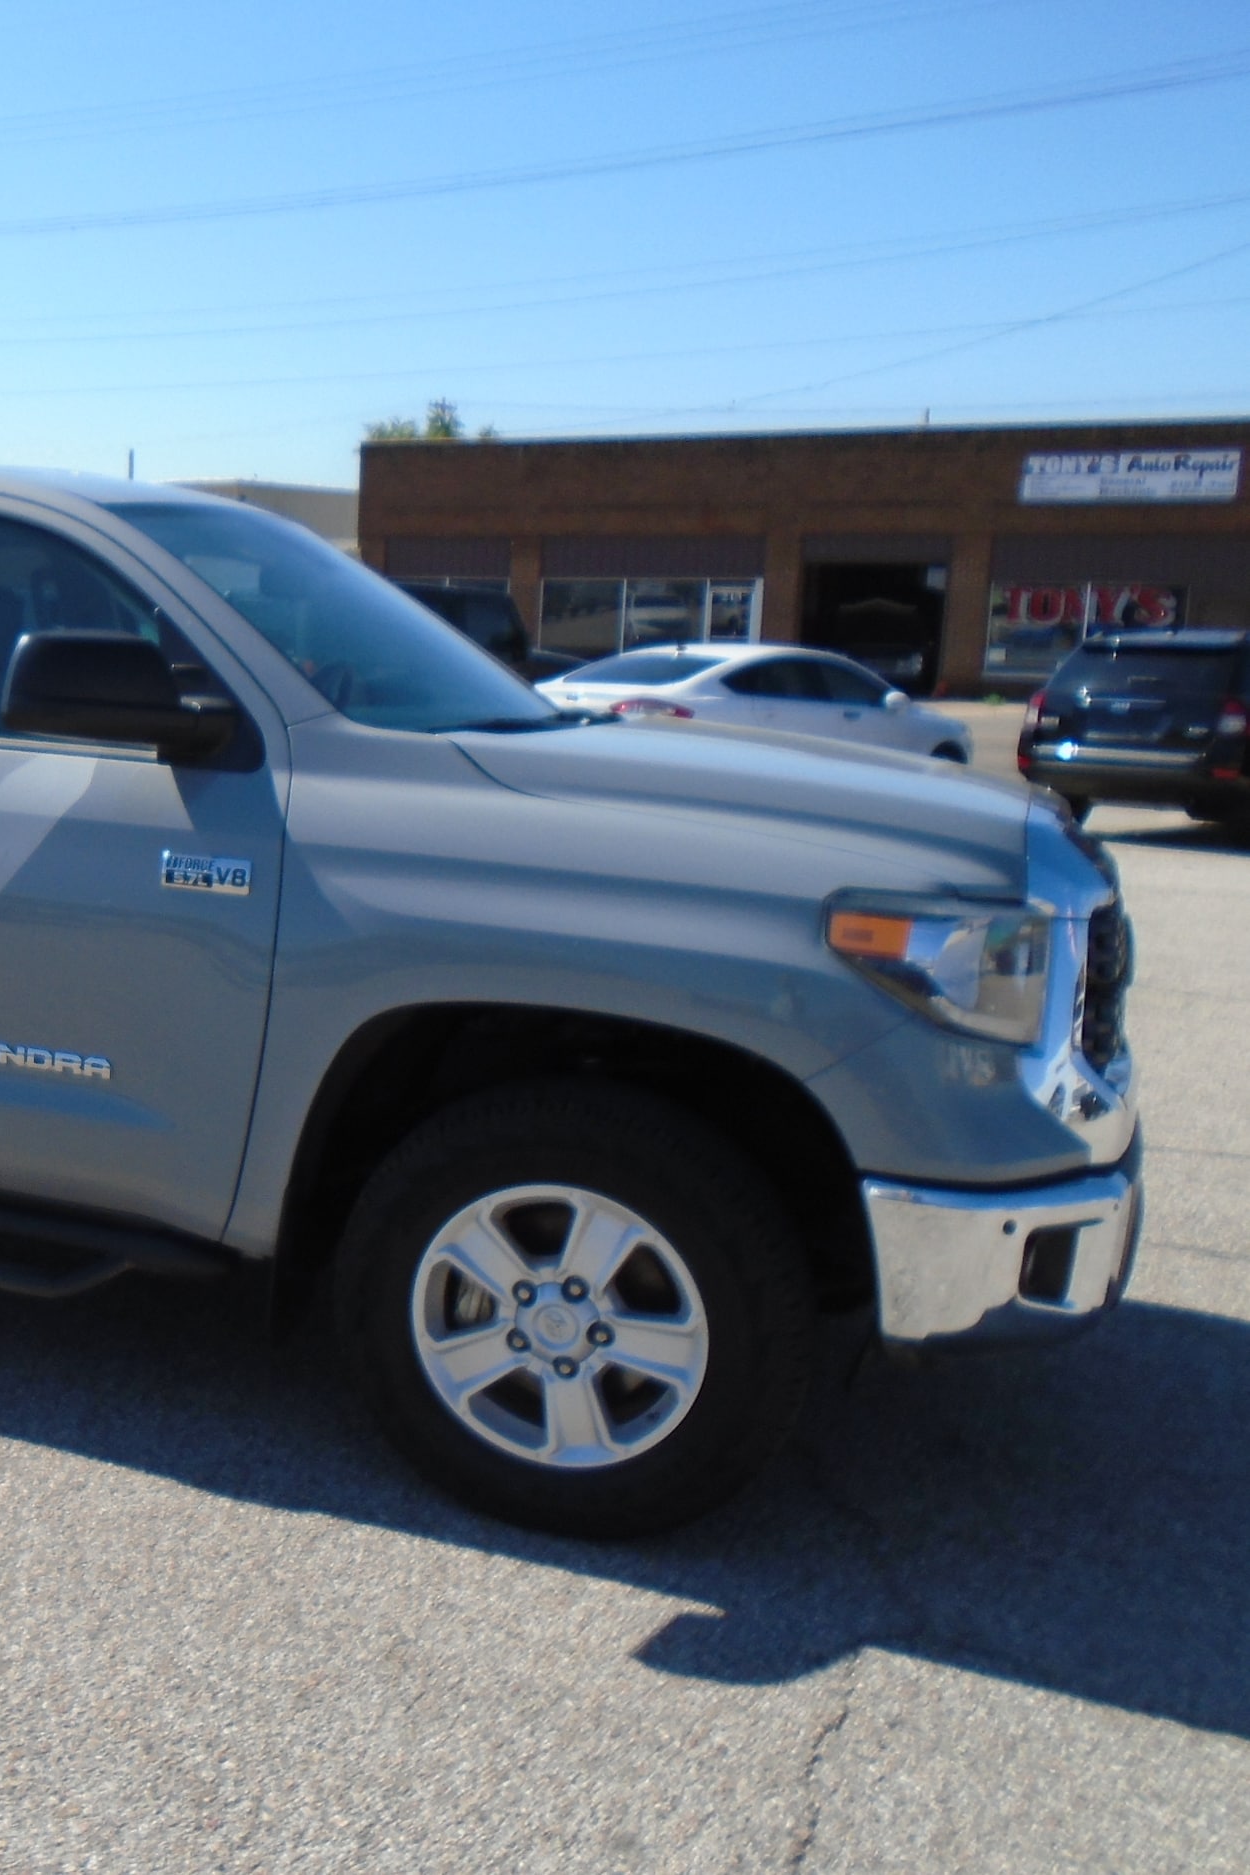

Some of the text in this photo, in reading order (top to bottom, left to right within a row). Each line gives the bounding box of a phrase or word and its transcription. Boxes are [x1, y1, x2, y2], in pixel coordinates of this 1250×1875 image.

[1028, 454, 1234, 478] TONY'S Auto Repair
[1005, 583, 1177, 626] TONY'S
[216, 867, 247, 887] V8
